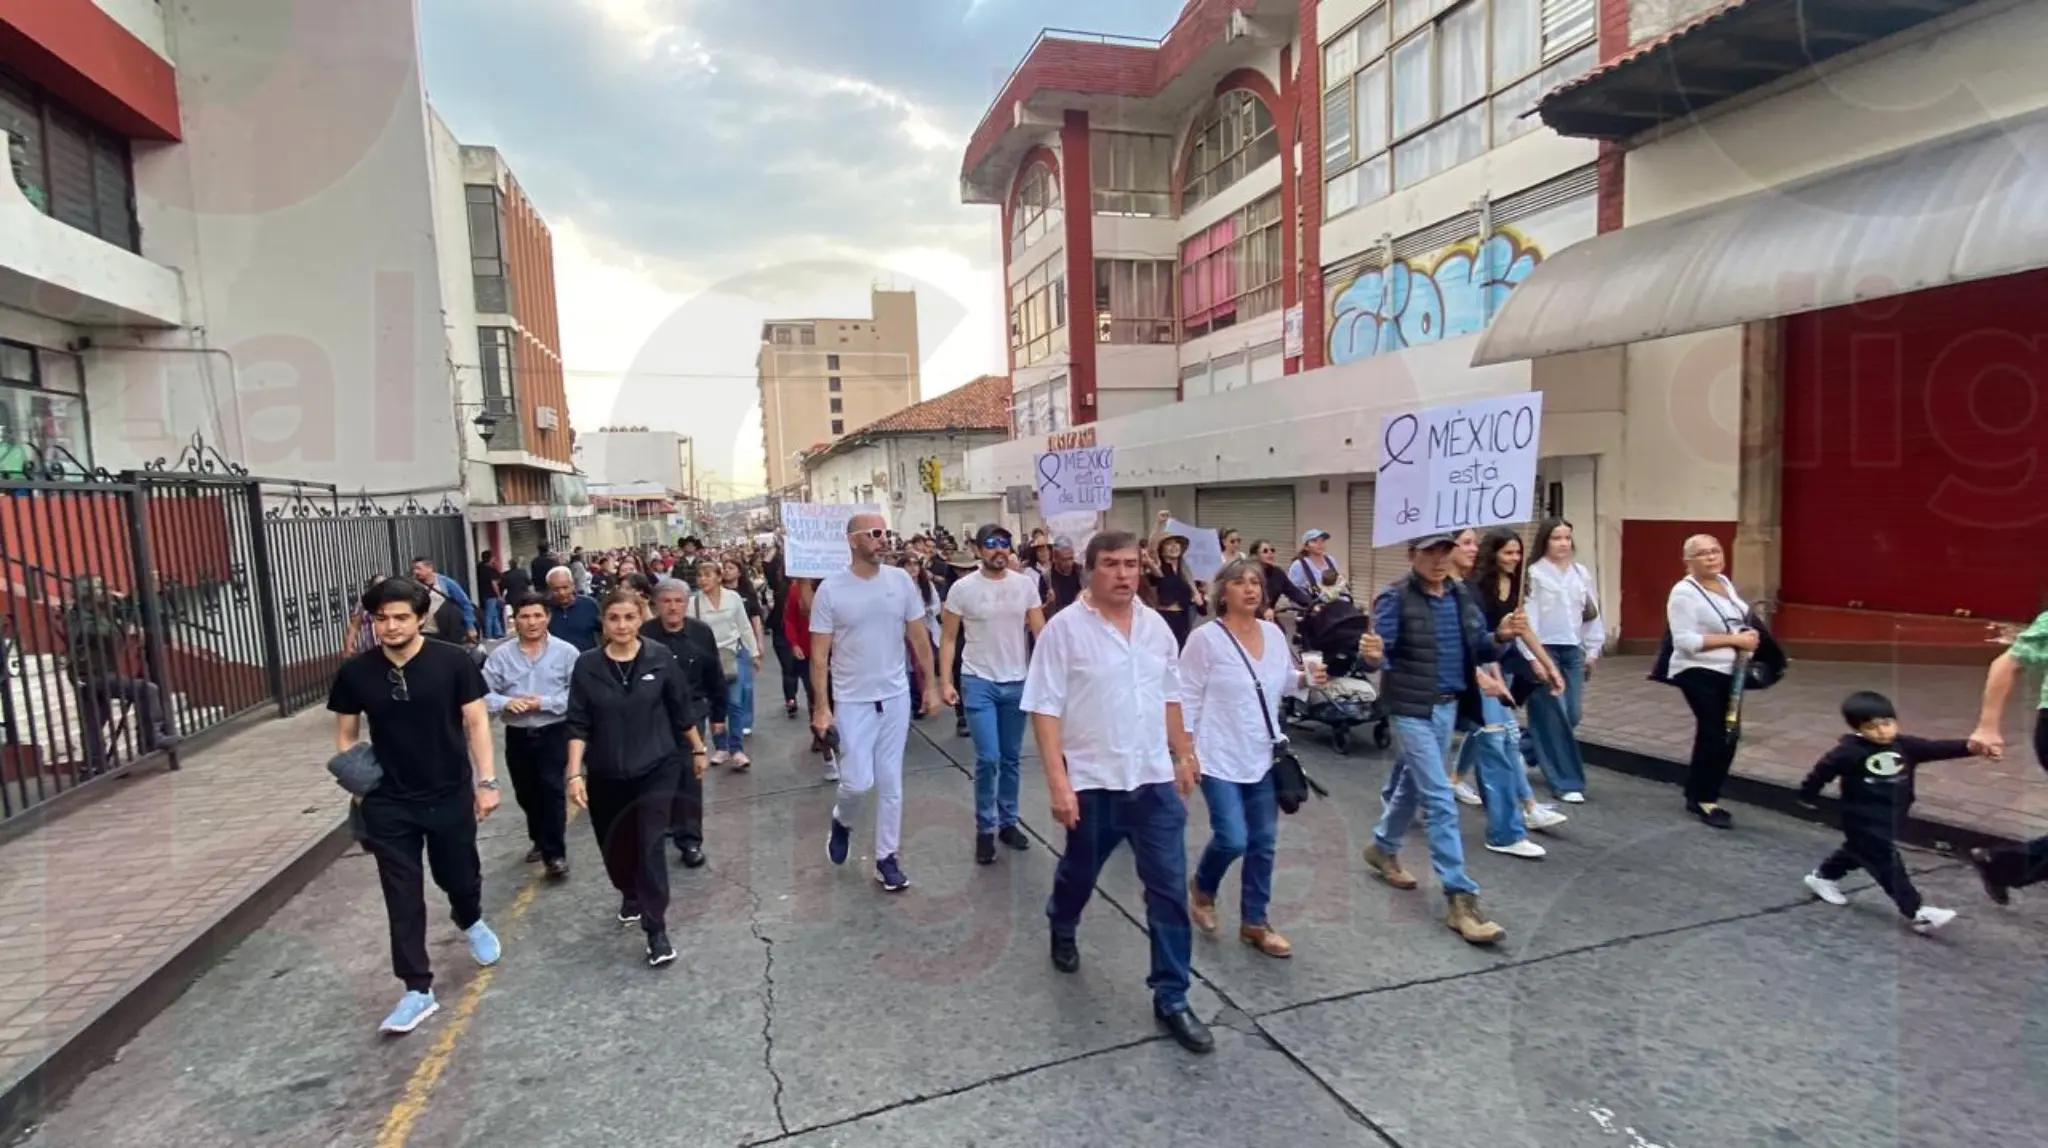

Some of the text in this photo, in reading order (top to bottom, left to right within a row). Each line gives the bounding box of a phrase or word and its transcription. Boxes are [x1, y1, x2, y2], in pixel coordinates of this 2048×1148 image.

[1428, 406, 1533, 460] MÉXICO
[1449, 457, 1498, 484] está
[1059, 488, 1073, 503] de
[1396, 482, 1517, 529] de LUTO
